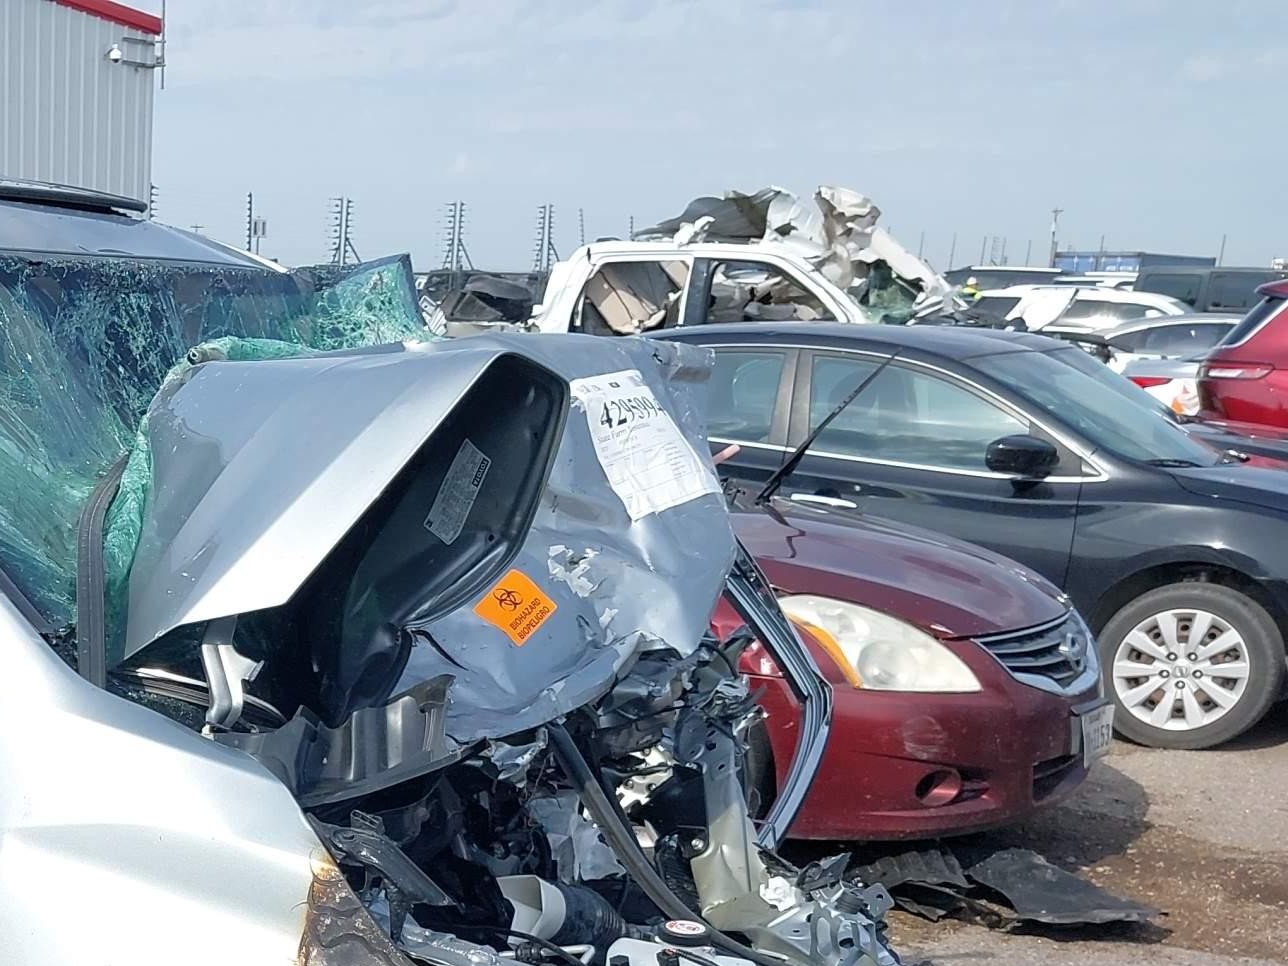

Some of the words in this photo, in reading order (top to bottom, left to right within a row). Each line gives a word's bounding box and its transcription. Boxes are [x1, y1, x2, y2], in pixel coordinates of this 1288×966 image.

[474, 461, 488, 486] TOYOTA
[509, 598, 541, 630] BIOHAZARD
[517, 606, 550, 639] BIOPELIGRO
